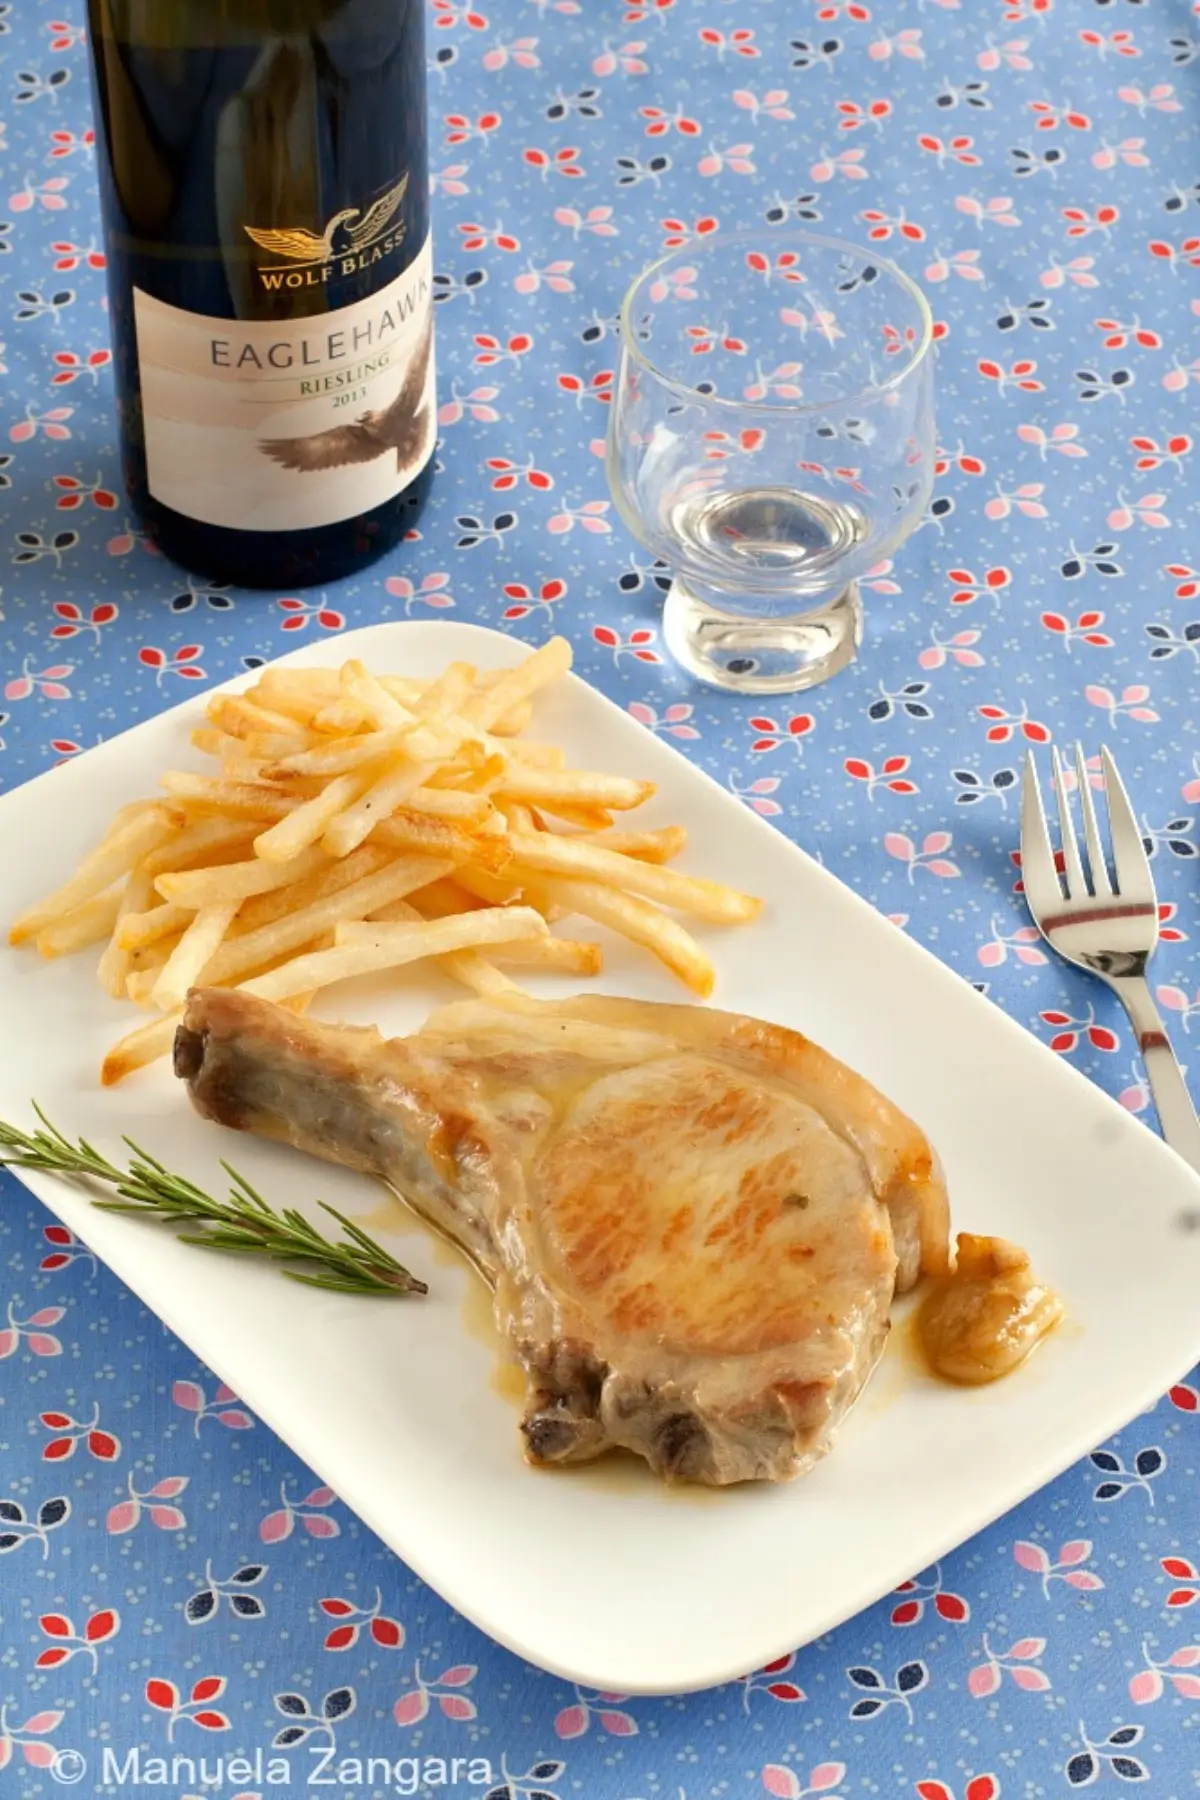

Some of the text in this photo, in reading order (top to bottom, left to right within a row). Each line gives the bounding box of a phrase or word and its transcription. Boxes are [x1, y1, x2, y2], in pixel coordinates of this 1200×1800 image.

[260, 230, 405, 291] WOLF BLASS
[300, 352, 390, 395] RIESLING
[332, 387, 367, 408] 2013
